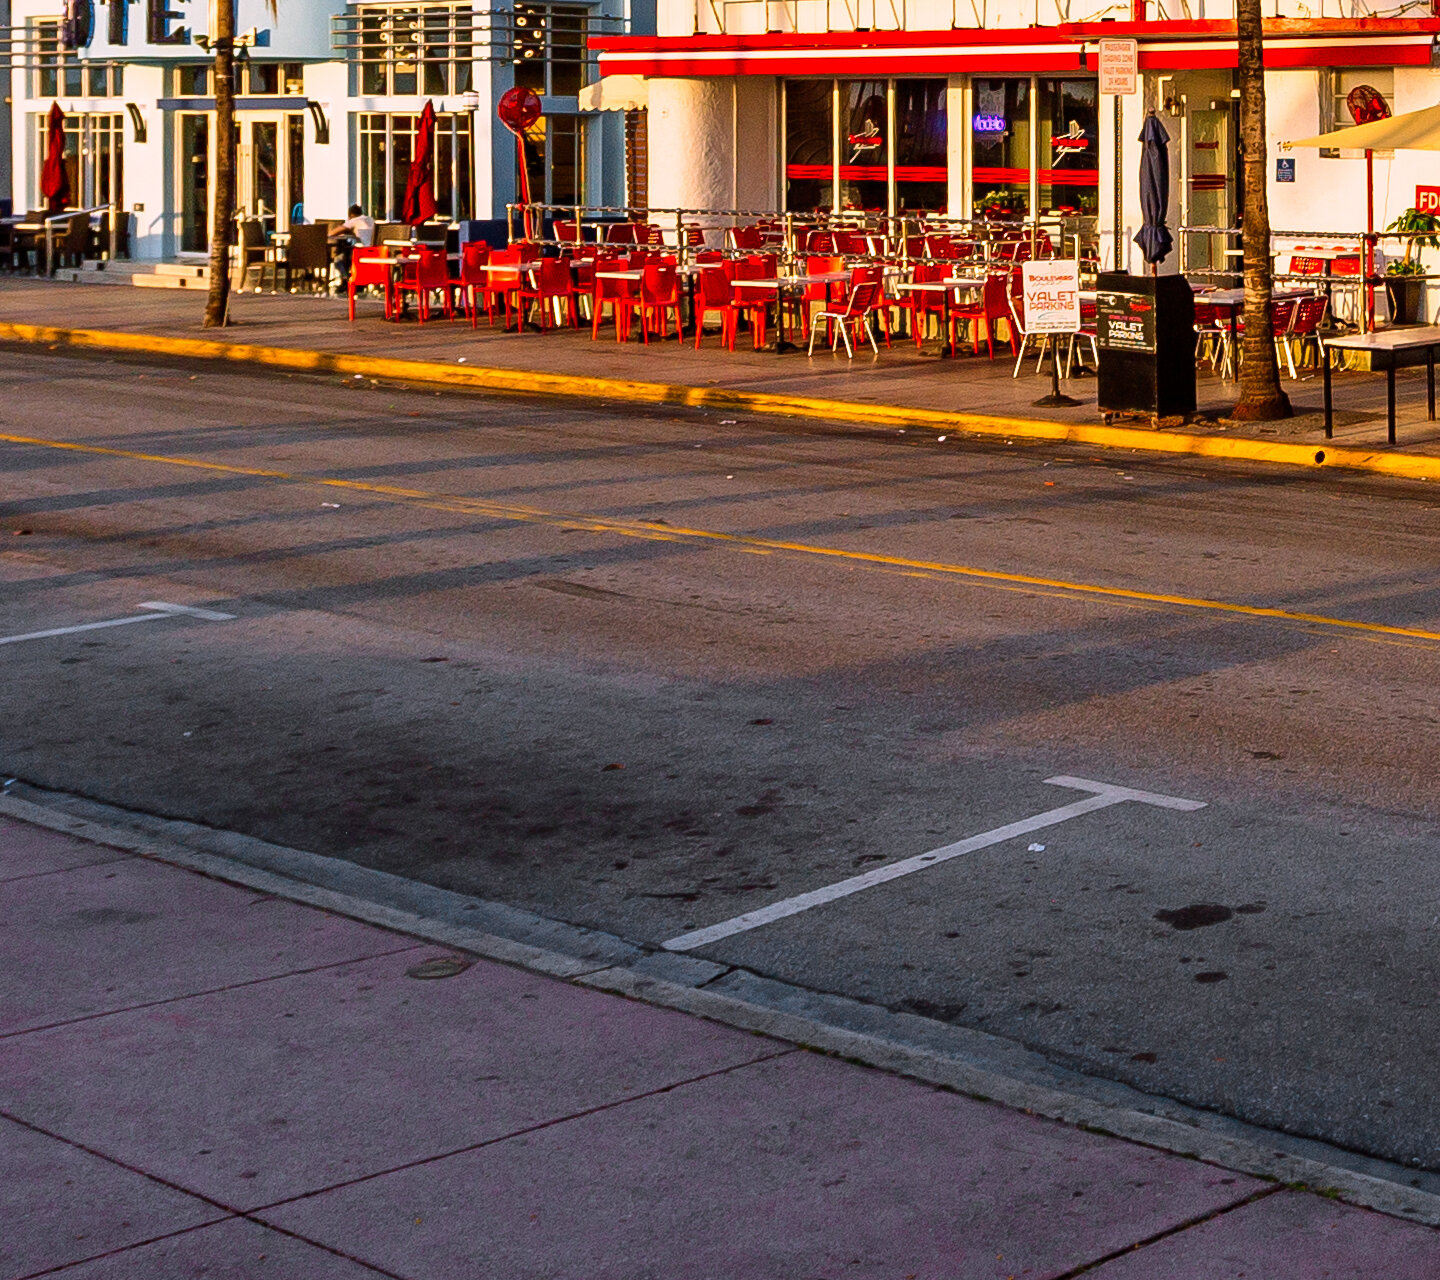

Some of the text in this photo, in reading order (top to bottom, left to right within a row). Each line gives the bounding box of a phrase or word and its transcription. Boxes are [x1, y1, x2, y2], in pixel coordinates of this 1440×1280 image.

[1027, 290, 1076, 301] VALET
[1029, 301, 1074, 311] PARKING
[1108, 321, 1144, 331] VALET
[1108, 330, 1144, 340] PARKING
